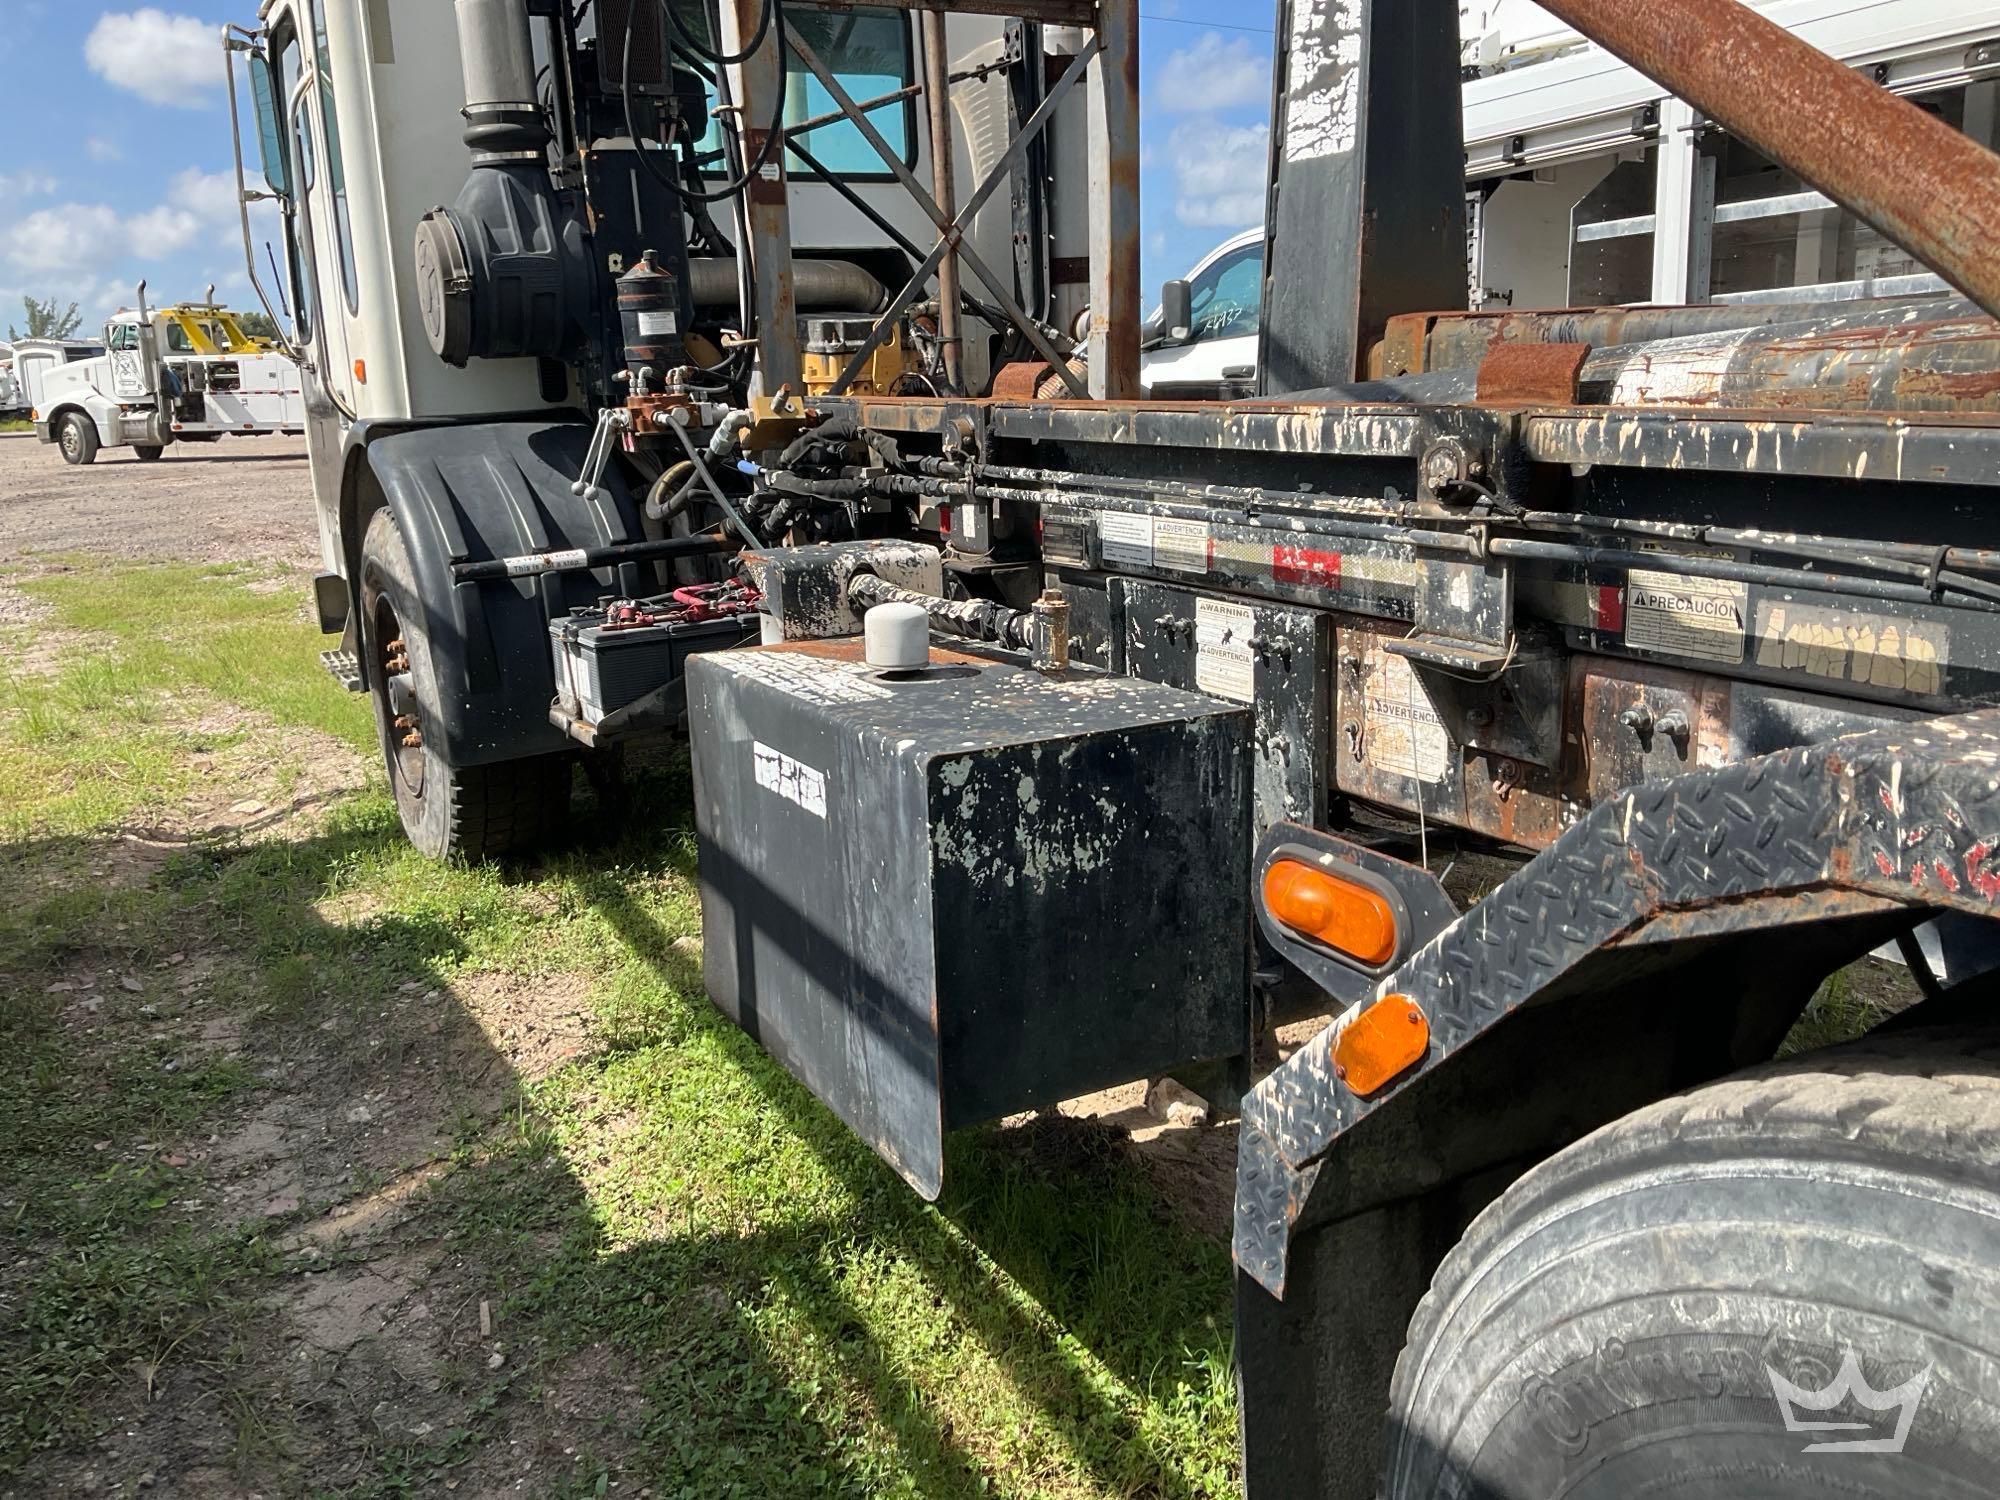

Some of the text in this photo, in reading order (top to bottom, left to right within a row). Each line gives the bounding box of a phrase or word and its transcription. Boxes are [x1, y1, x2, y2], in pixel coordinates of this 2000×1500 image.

[1162, 523, 1203, 535] ADVERTENCIA
[513, 565, 531, 573] This
[1205, 603, 1250, 618] WARNING
[1206, 646, 1250, 663] ADVERTENCIA
